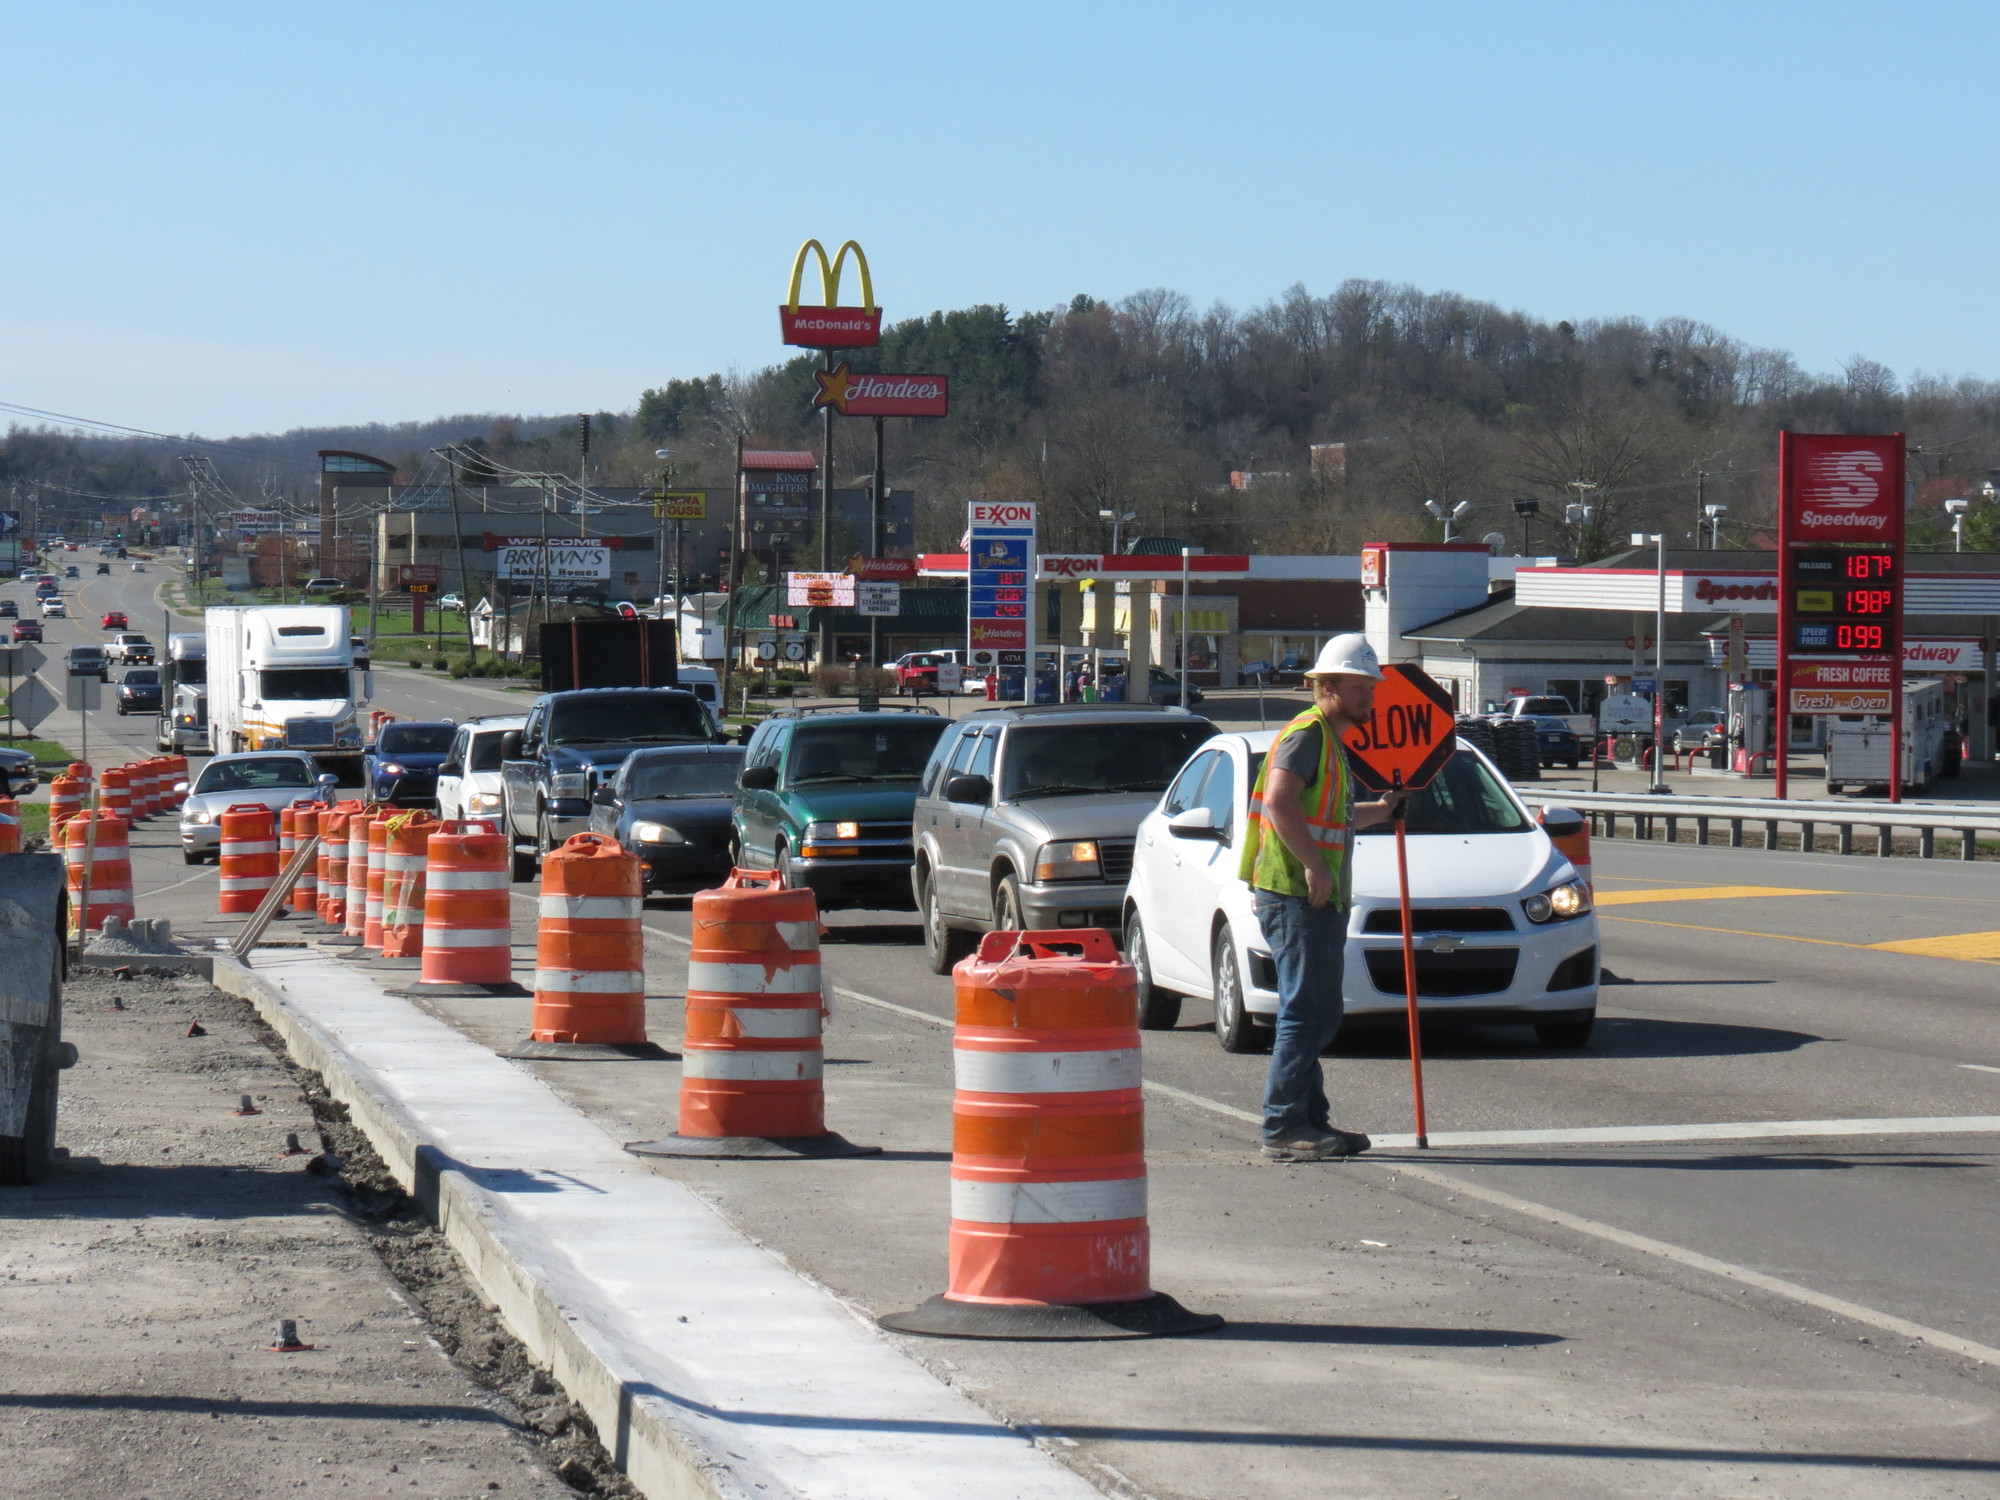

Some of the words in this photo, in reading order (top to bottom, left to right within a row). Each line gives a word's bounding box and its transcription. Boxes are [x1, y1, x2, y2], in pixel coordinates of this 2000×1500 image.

[794, 318, 871, 331] McDonald's
[844, 377, 945, 401] Hardee's
[975, 504, 1031, 526] EXXON
[1801, 510, 1888, 530] Speedway
[1043, 557, 1098, 577] EXXON
[1801, 627, 1827, 636] SPEEDY
[1837, 625, 1882, 648] 0.99
[1801, 636, 1827, 645] FREEZE
[792, 646, 798, 657] 7
[1003, 654, 1022, 662] ATM
[1816, 667, 1850, 683] FRESH
[1852, 667, 1891, 683] COFFEE
[1797, 693, 1834, 708] Fresh
[1850, 695, 1886, 709] Oven
[1351, 703, 1433, 752] SLOW
